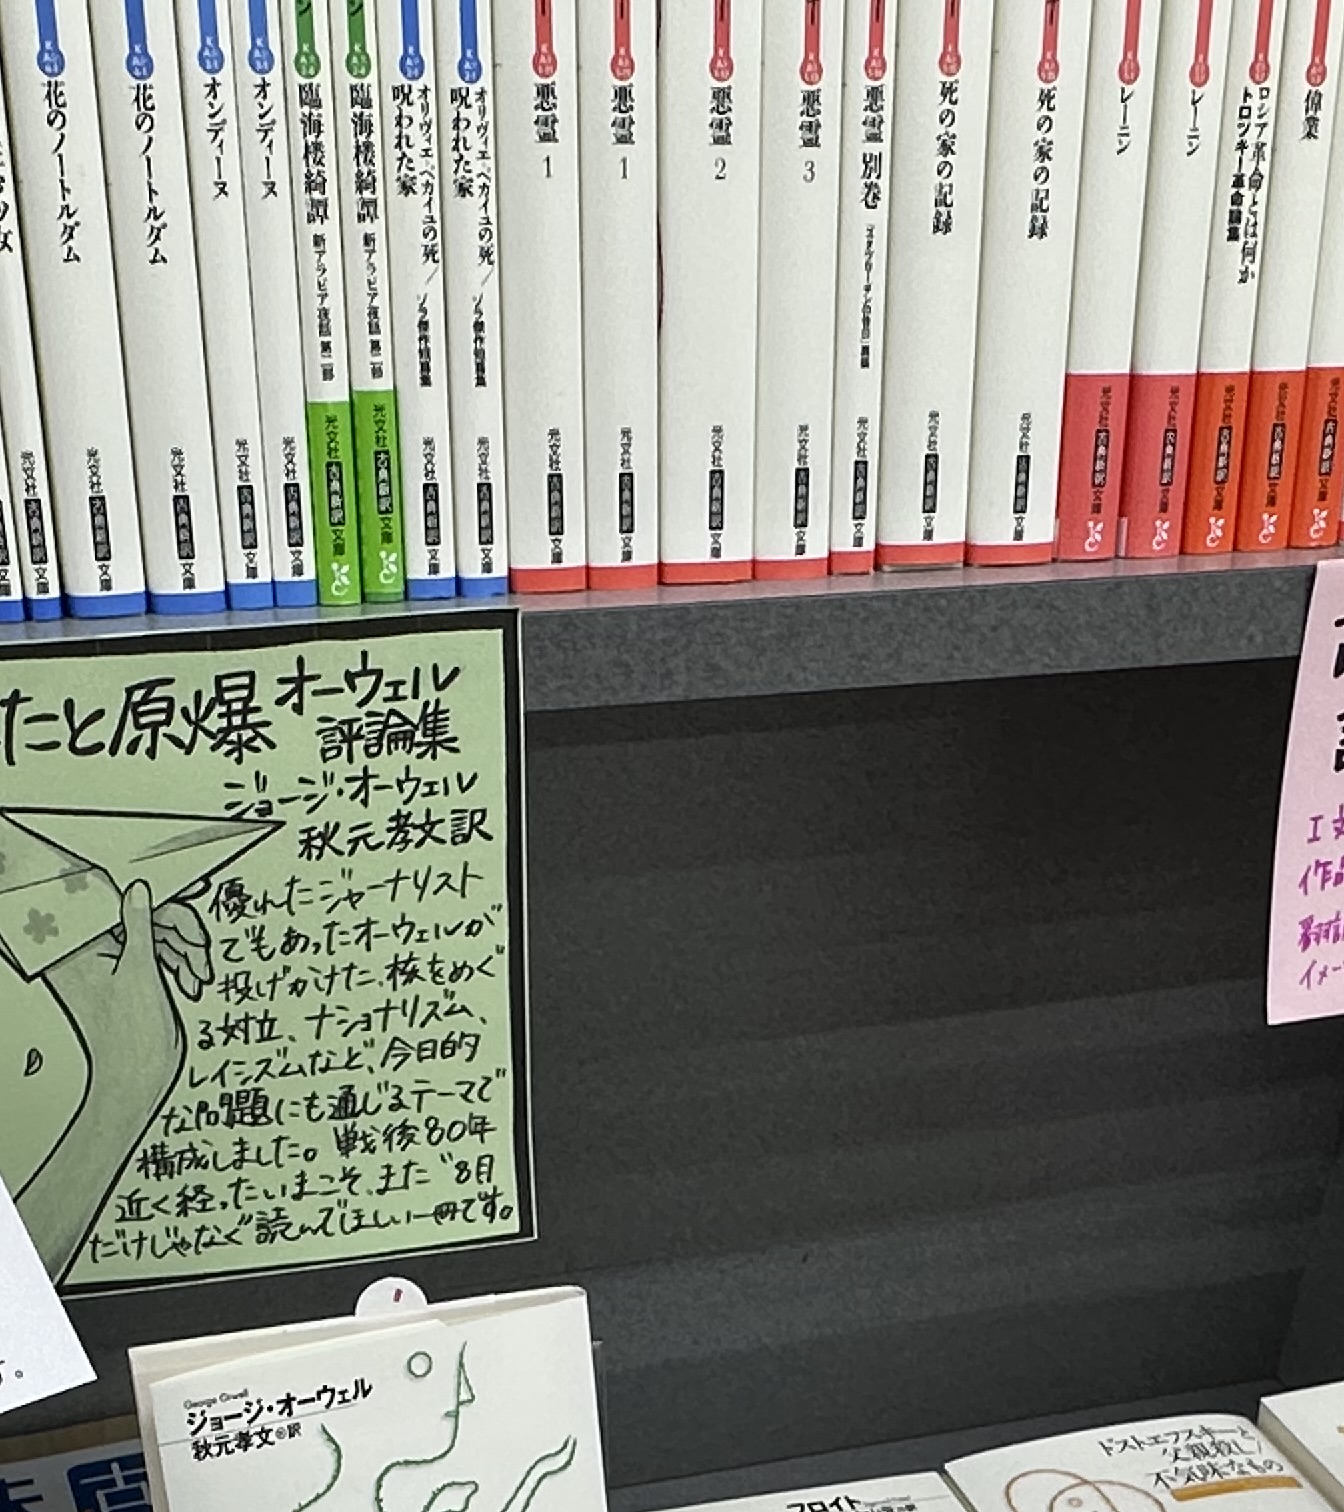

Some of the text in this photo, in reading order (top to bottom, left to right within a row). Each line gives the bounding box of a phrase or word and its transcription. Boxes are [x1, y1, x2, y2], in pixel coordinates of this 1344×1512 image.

[204, 84, 230, 199] オンディーヌ
[254, 82, 278, 199] オンディーヌ
[392, 84, 417, 198] 呪われた家
[450, 86, 474, 198] 呪われた家
[1115, 86, 1131, 156] レーニン
[1186, 88, 1204, 157] レーニン
[44, 80, 81, 264] 花のノートルダム
[132, 84, 168, 265] 花のノートルダム
[542, 156, 553, 178] 1
[620, 156, 629, 180] 1
[714, 158, 727, 181] 2
[802, 160, 816, 183] 3
[933, 79, 958, 236] 死の家の記録
[1027, 85, 1057, 240] 死の家の記録
[275, 651, 461, 714] オーウェル
[317, 699, 460, 765] 評論集
[222, 767, 479, 820] ジョージ・オーウェル
[297, 808, 492, 862] 秋元孝文訳
[209, 864, 484, 924] 優れたジャーナリスト
[334, 1113, 497, 1159] 戦後80年
[185, 1377, 373, 1436] ジョージ・オーウェル
